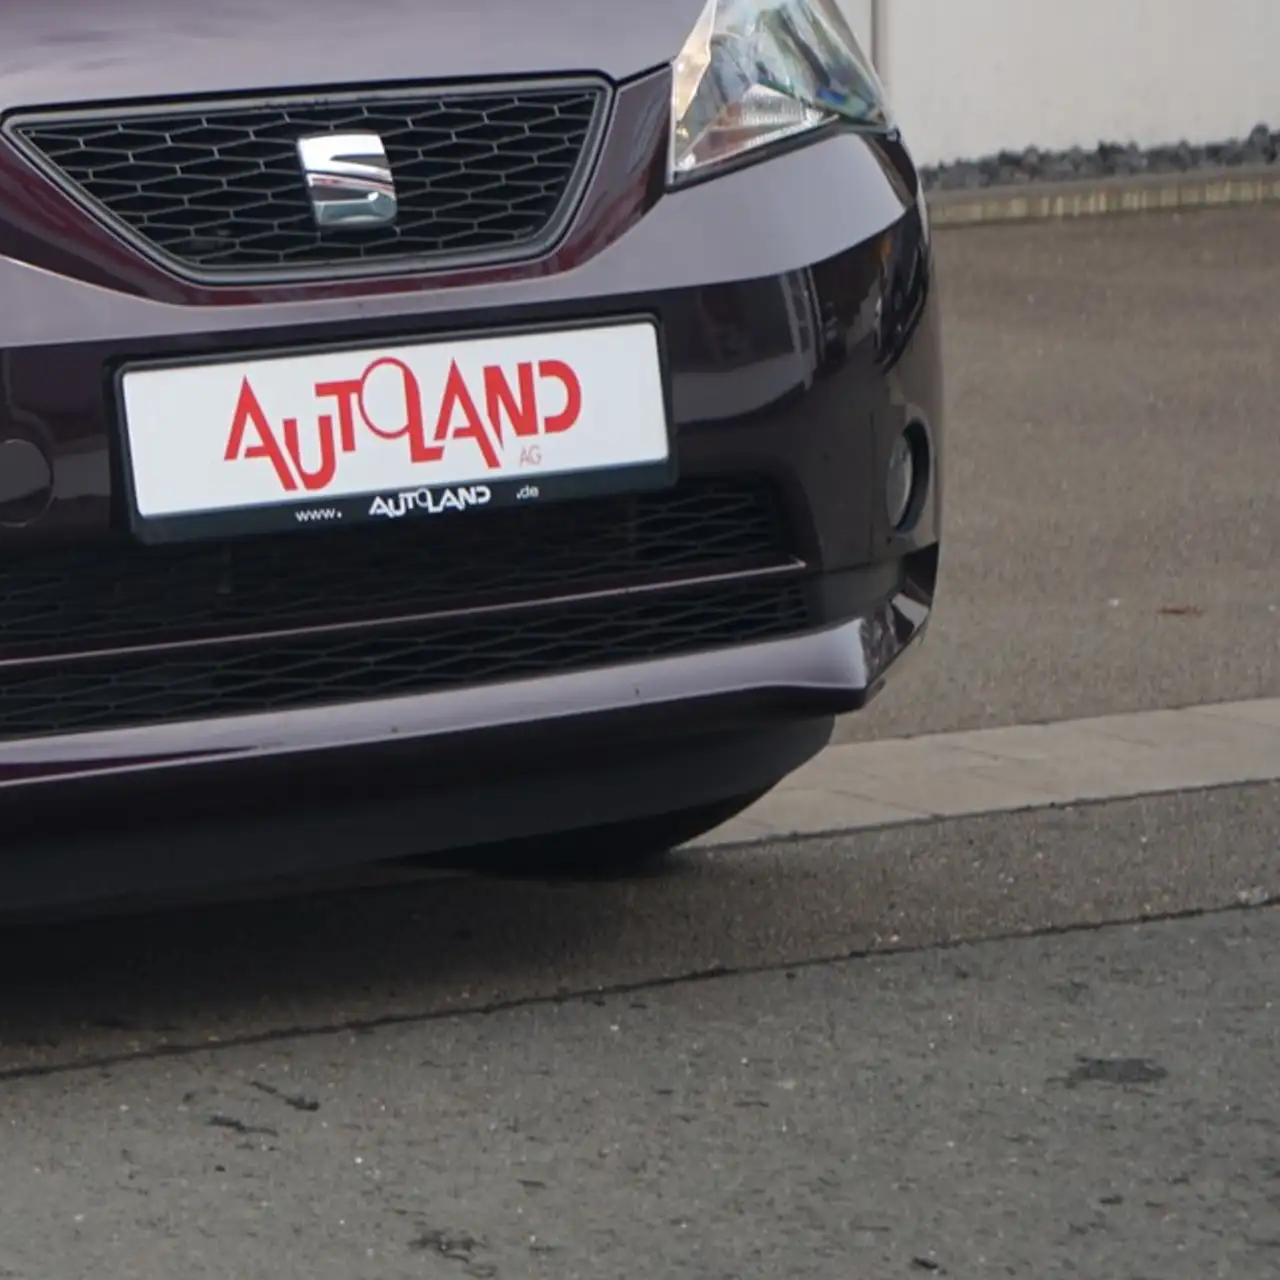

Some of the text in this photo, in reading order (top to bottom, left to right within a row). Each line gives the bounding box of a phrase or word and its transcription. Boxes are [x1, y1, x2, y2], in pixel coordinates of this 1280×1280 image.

[223, 356, 582, 492] AUTOLAND
[519, 444, 543, 468] AG
[368, 484, 492, 519] AUTOLAND
